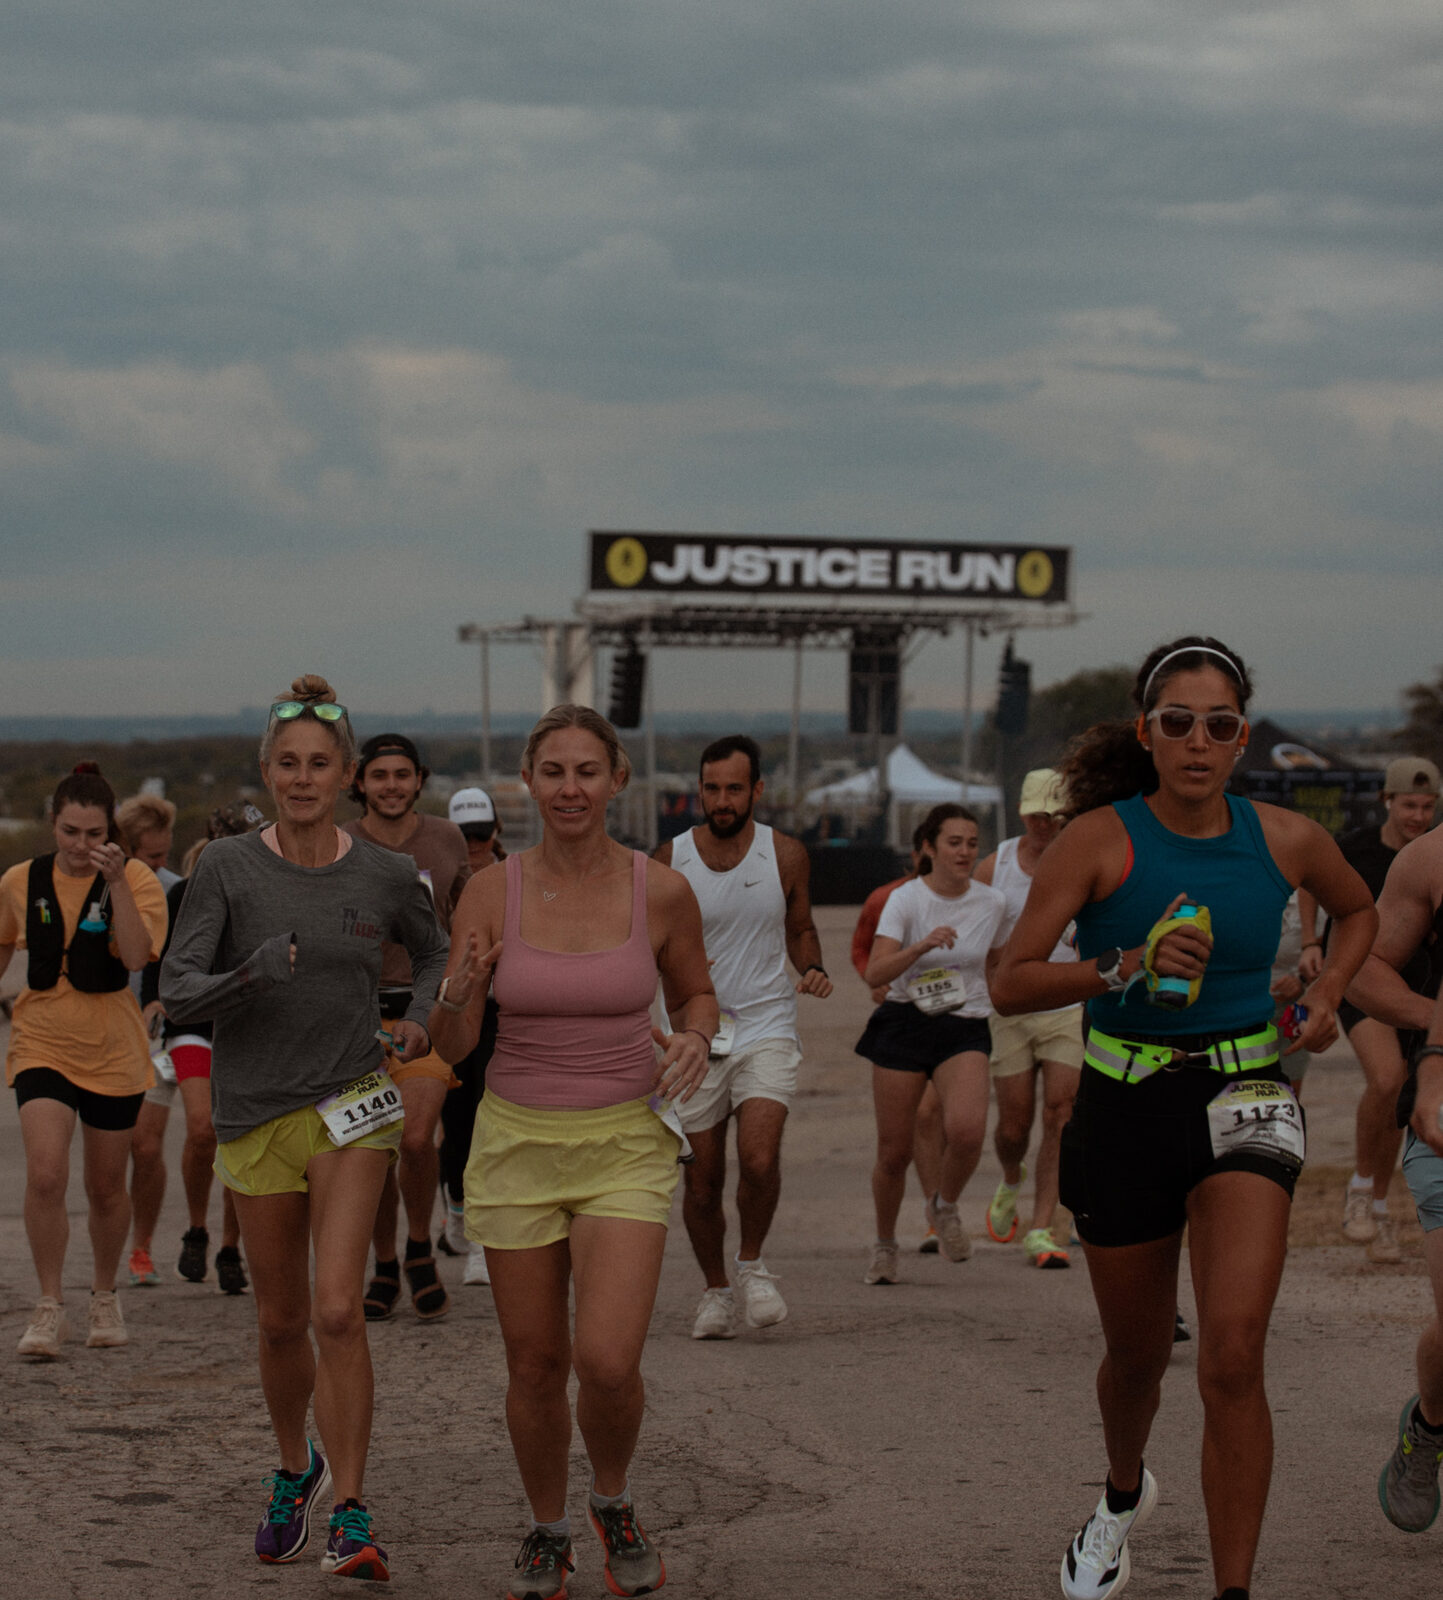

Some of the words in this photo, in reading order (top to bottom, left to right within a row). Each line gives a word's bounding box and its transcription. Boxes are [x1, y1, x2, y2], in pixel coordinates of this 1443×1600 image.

[649, 543, 892, 590] JUSTICE
[897, 549, 1016, 592] RUN
[336, 1075, 376, 1098] JUSTICE
[357, 1081, 379, 1095] RUN
[1231, 1083, 1277, 1092] JUSTICE
[1255, 1089, 1280, 1097] RUN
[344, 1090, 398, 1124] 1140
